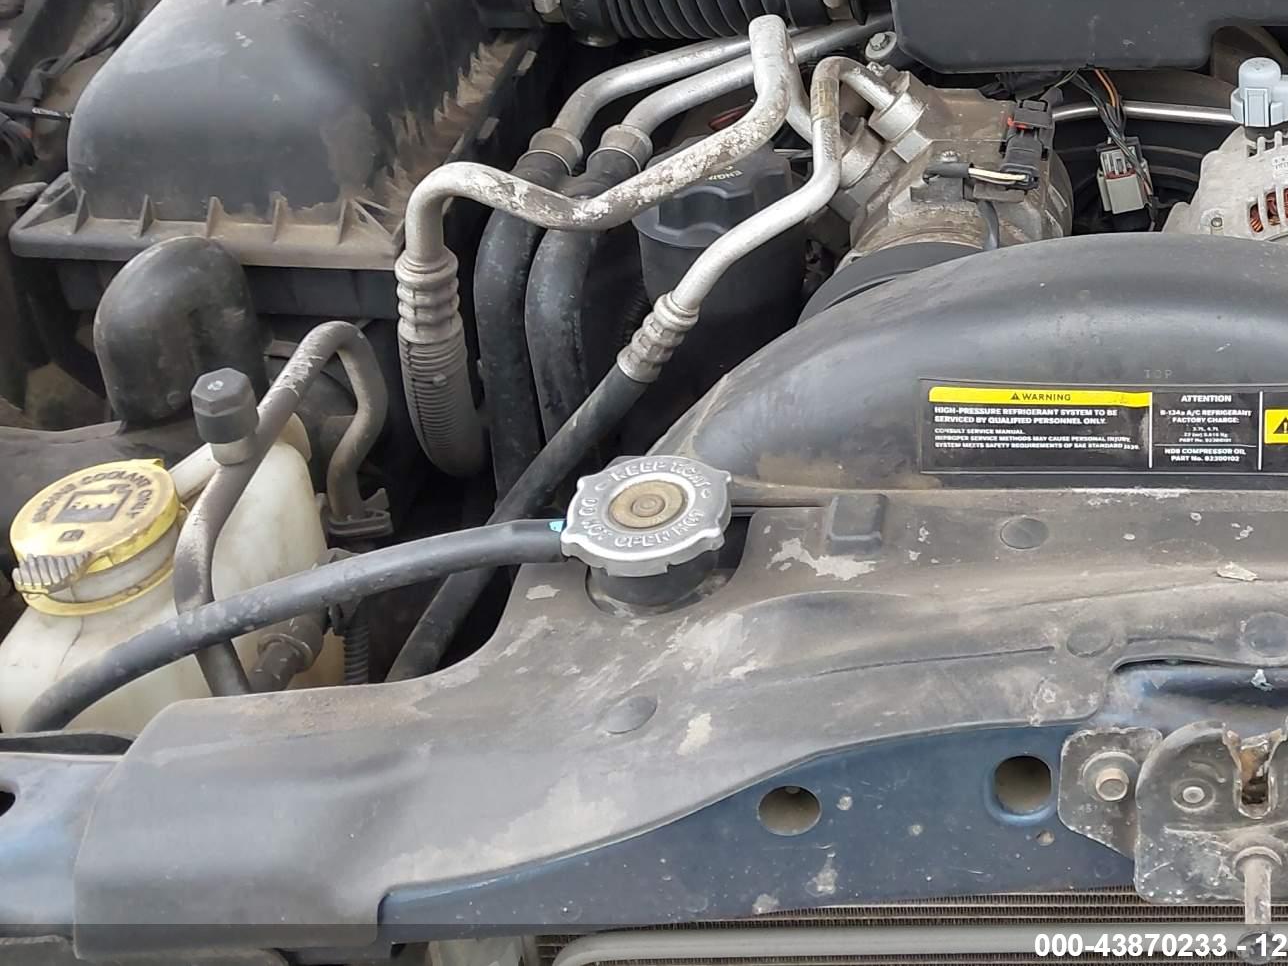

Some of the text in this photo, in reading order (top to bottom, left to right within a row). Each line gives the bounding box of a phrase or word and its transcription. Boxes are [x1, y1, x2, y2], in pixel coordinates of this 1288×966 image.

[1022, 393, 1071, 401] WARNING
[1180, 395, 1232, 403] ATTENTION
[934, 406, 1002, 415] HIGH-PRESSURE
[1002, 408, 1060, 416] REFRIGERANT
[1186, 409, 1201, 417] A/C
[81, 470, 151, 488] COOLANT
